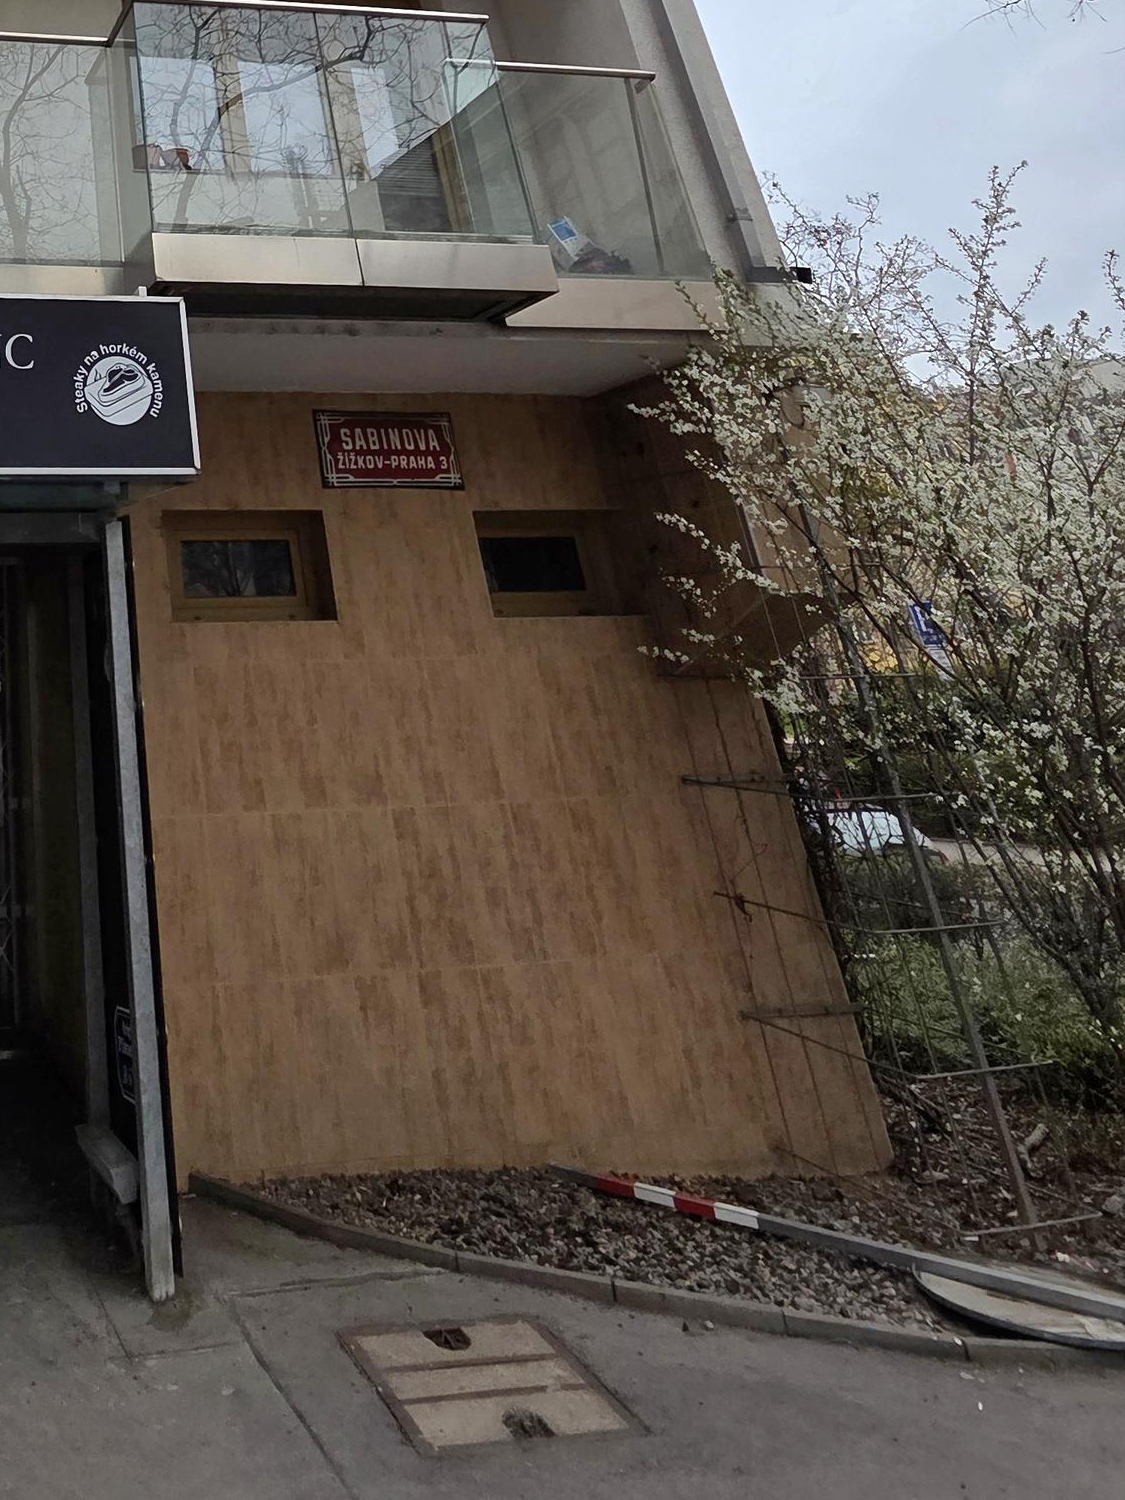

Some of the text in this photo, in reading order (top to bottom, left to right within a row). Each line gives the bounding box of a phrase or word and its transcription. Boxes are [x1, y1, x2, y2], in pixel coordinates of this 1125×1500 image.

[74, 343, 163, 418] Steaky na horkém kamenu
[340, 428, 440, 451] SABINOVA
[439, 456, 448, 469] 3
